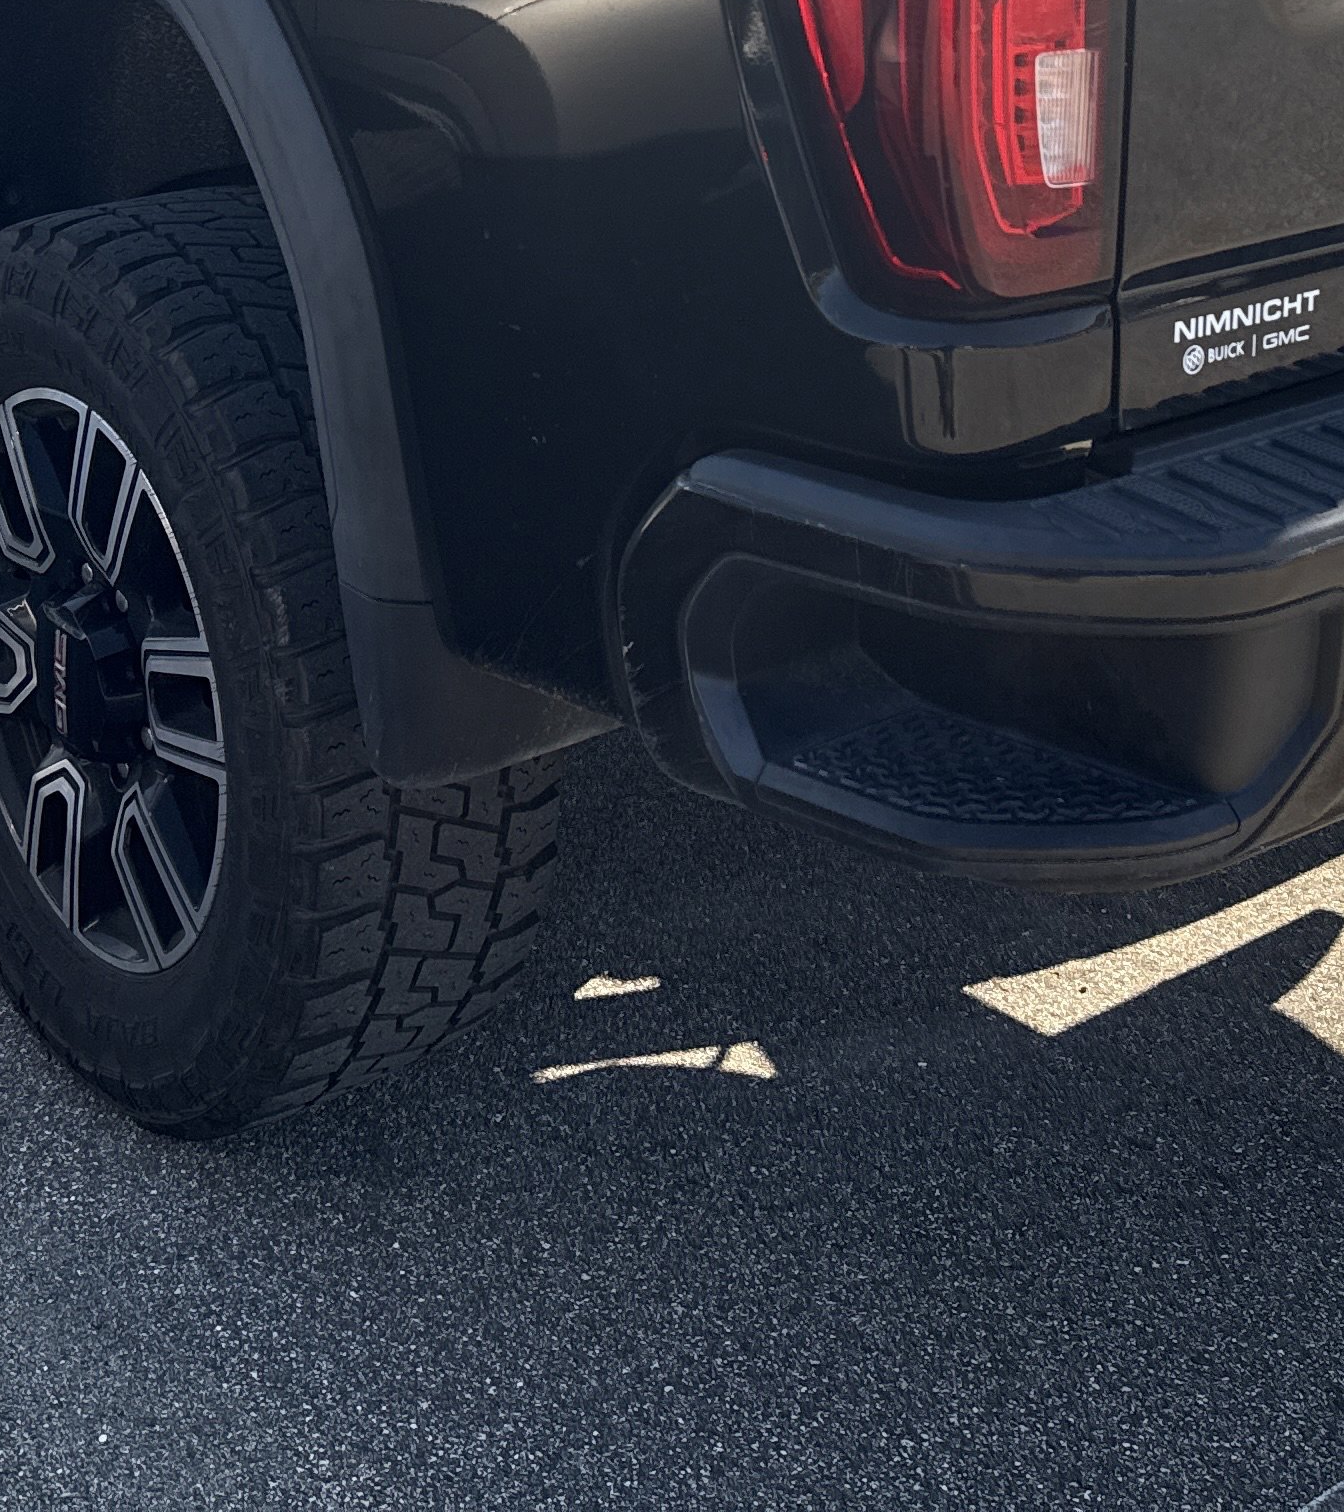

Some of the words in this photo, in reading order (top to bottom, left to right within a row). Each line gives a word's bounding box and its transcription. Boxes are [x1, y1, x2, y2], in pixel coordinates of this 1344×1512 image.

[1173, 289, 1320, 343] NIMNICHT
[1208, 341, 1245, 364] BUICK
[1262, 325, 1311, 350] GMC
[54, 628, 69, 736] GMC
